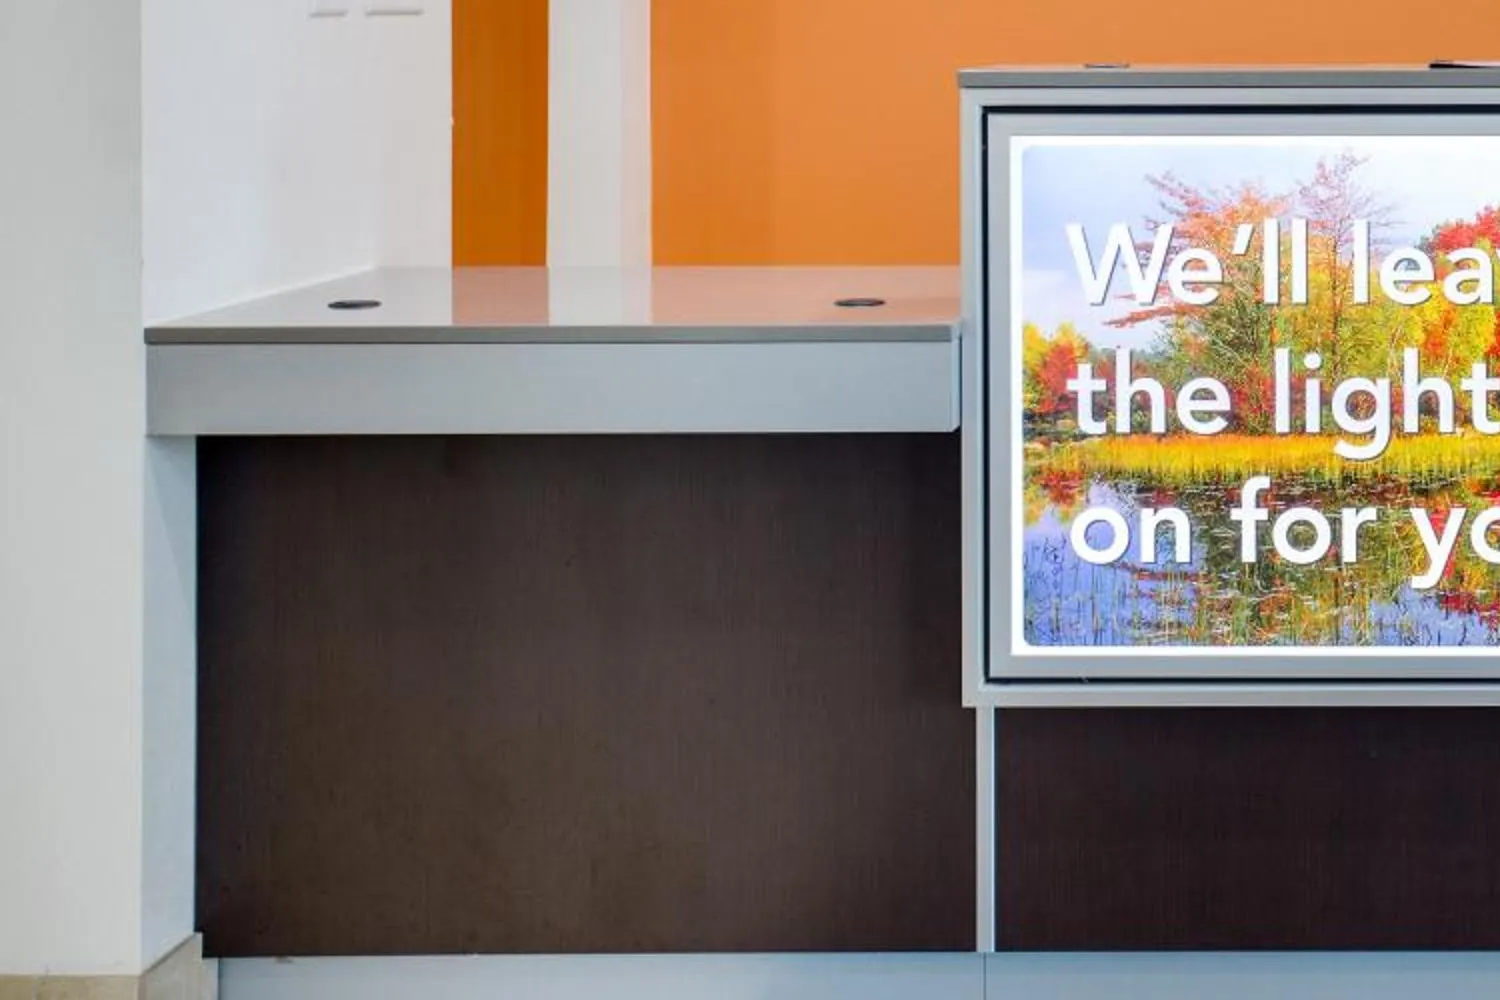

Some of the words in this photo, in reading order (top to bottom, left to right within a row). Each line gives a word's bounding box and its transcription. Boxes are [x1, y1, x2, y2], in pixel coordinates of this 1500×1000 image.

[1065, 217, 1308, 305] We'll
[1066, 347, 1232, 435] the
[1069, 504, 1193, 565] on
[1231, 475, 1378, 565] for
